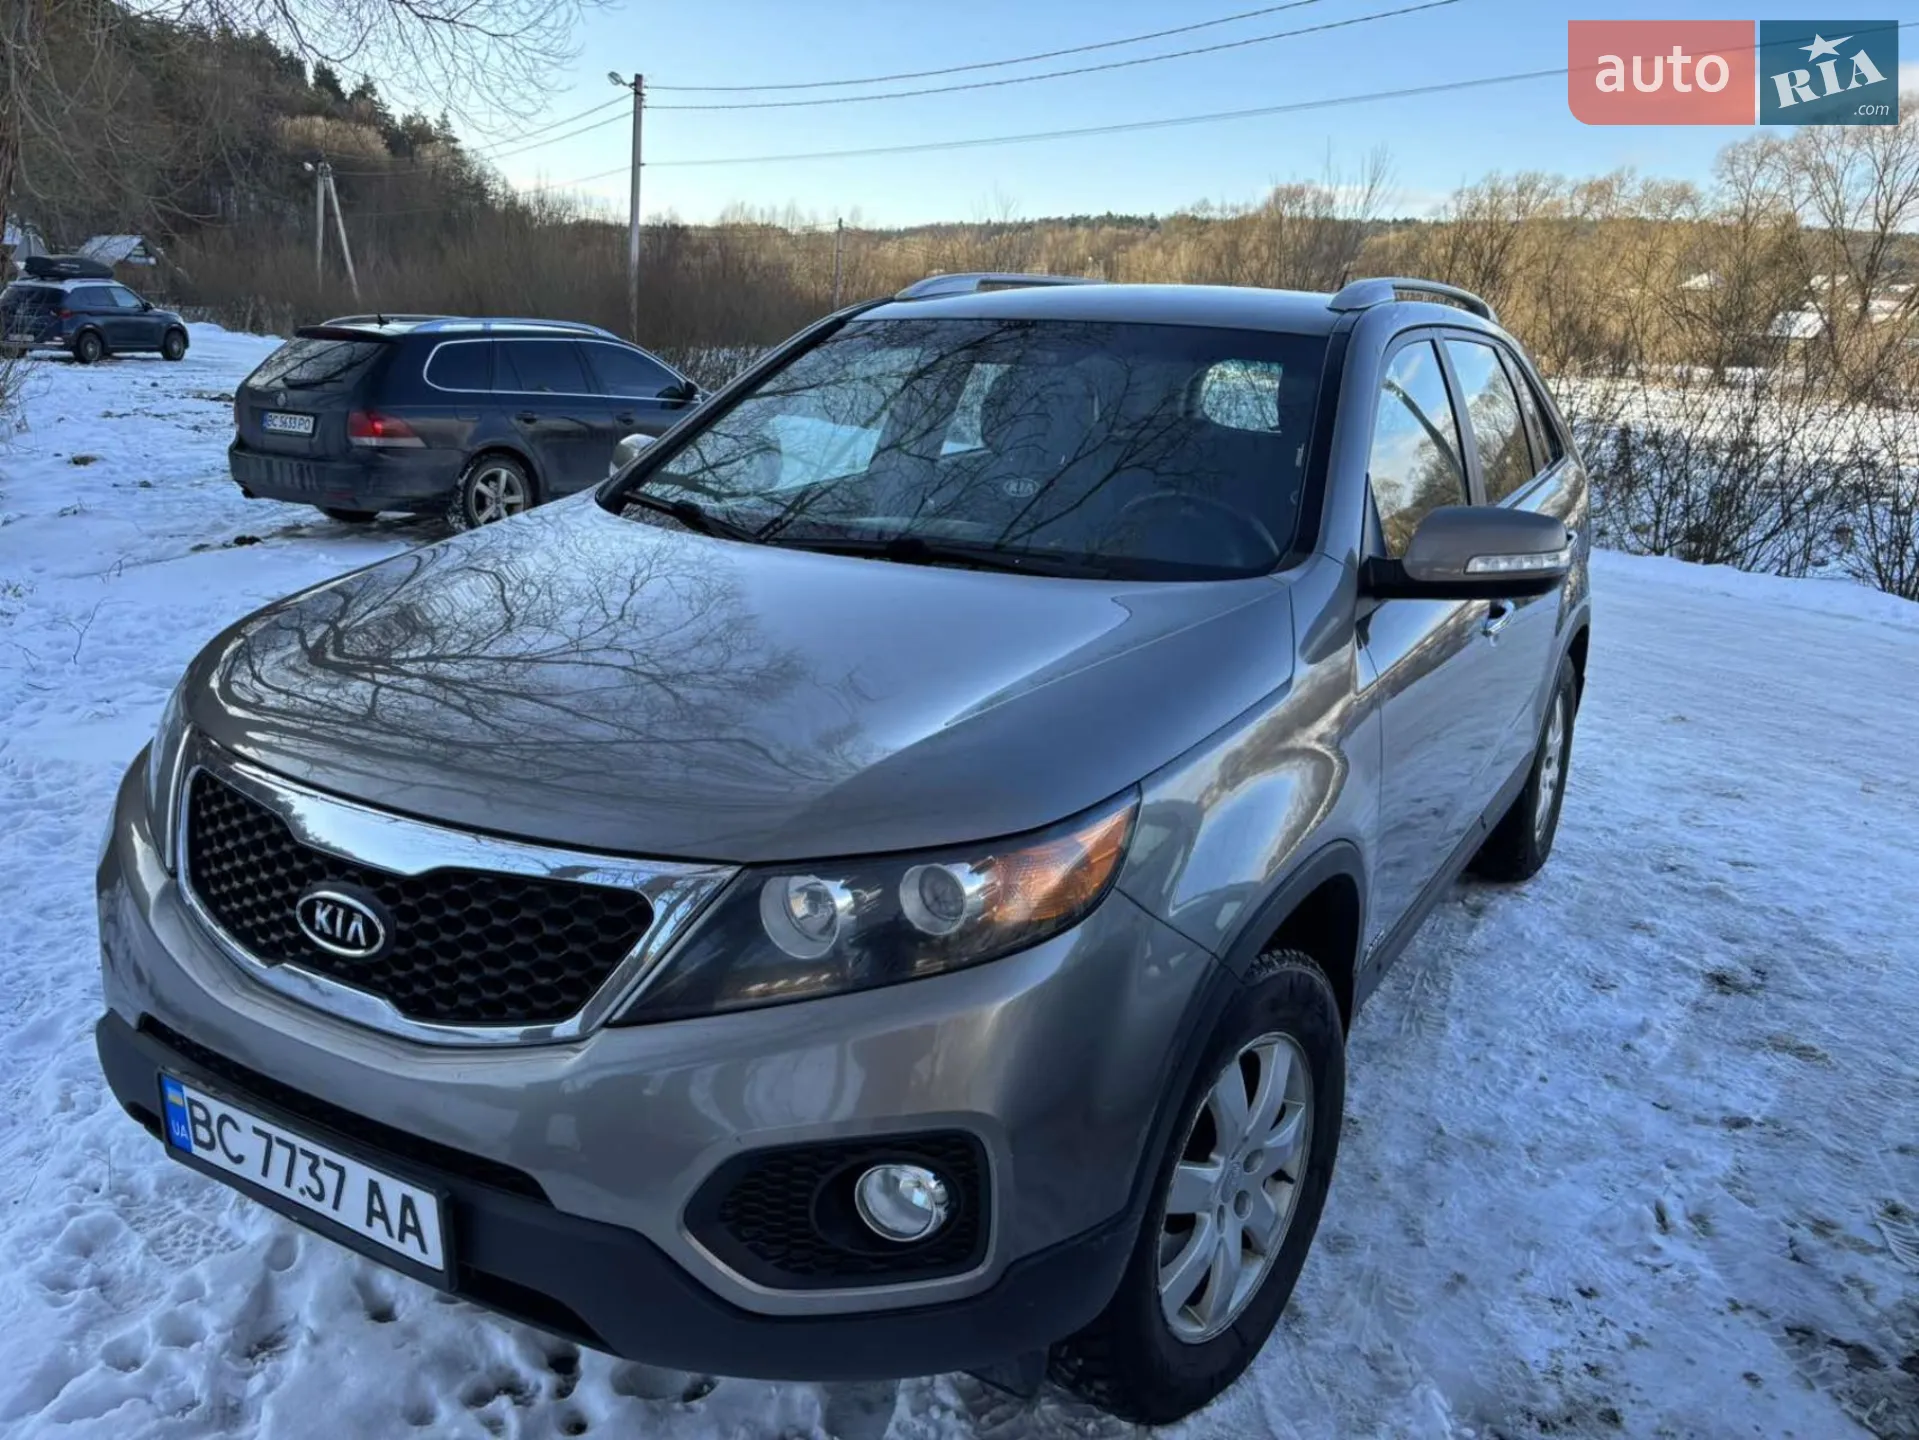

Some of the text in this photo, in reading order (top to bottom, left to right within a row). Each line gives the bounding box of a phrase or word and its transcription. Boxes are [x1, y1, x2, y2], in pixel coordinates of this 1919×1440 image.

[315, 900, 367, 946] KIA
[172, 1122, 189, 1139] UA
[187, 1097, 428, 1255] BC 7737 AA
